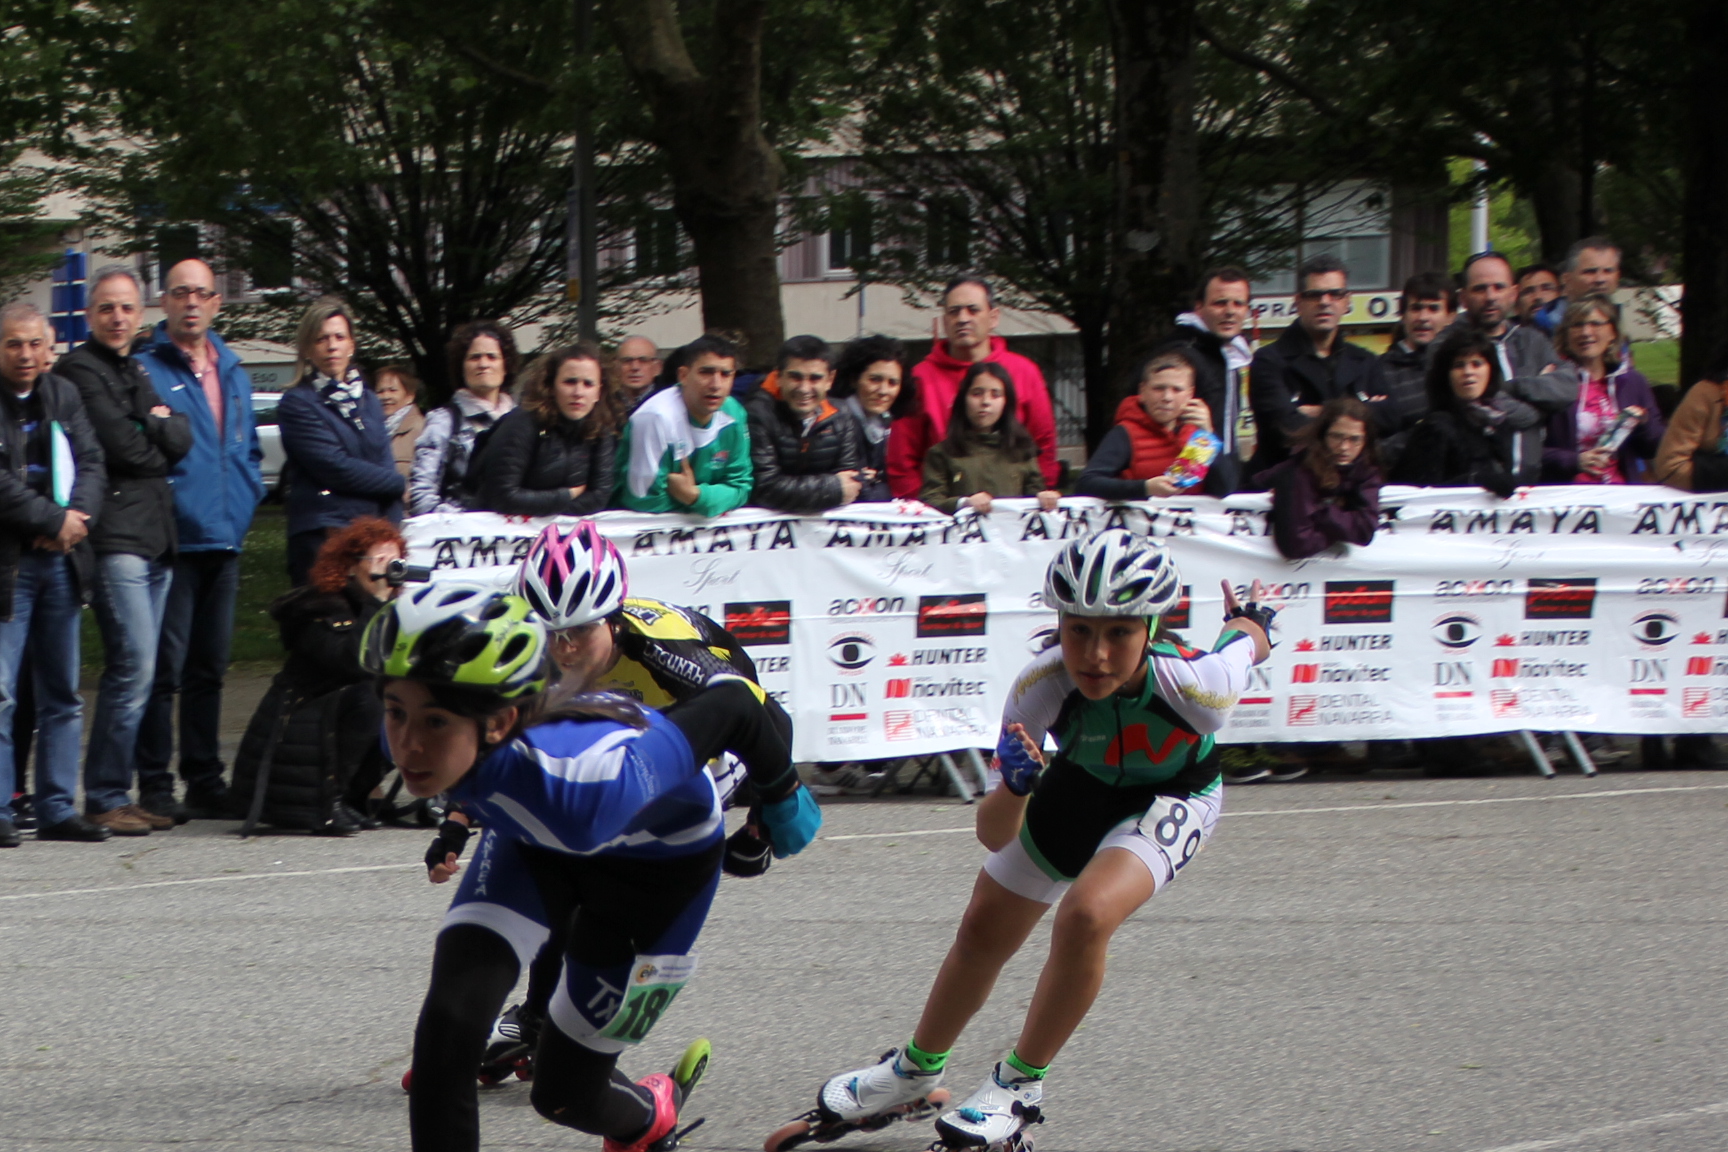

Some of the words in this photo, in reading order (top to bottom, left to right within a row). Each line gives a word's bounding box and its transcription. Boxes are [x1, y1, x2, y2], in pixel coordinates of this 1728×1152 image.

[1429, 505, 1603, 535] AMAYA
[630, 519, 800, 557] AMAYA
[429, 534, 538, 571] AMA
[1320, 634, 1393, 651] HUNTER
[1520, 630, 1592, 647] HUNTER
[754, 656, 791, 675] TER
[912, 647, 988, 666] HUNTER
[1318, 664, 1392, 683] novitec
[1433, 661, 1473, 686] DN
[1628, 658, 1670, 683] DN
[829, 682, 868, 709] DN
[911, 678, 988, 699] novitec
[613, 986, 681, 1040] 18
